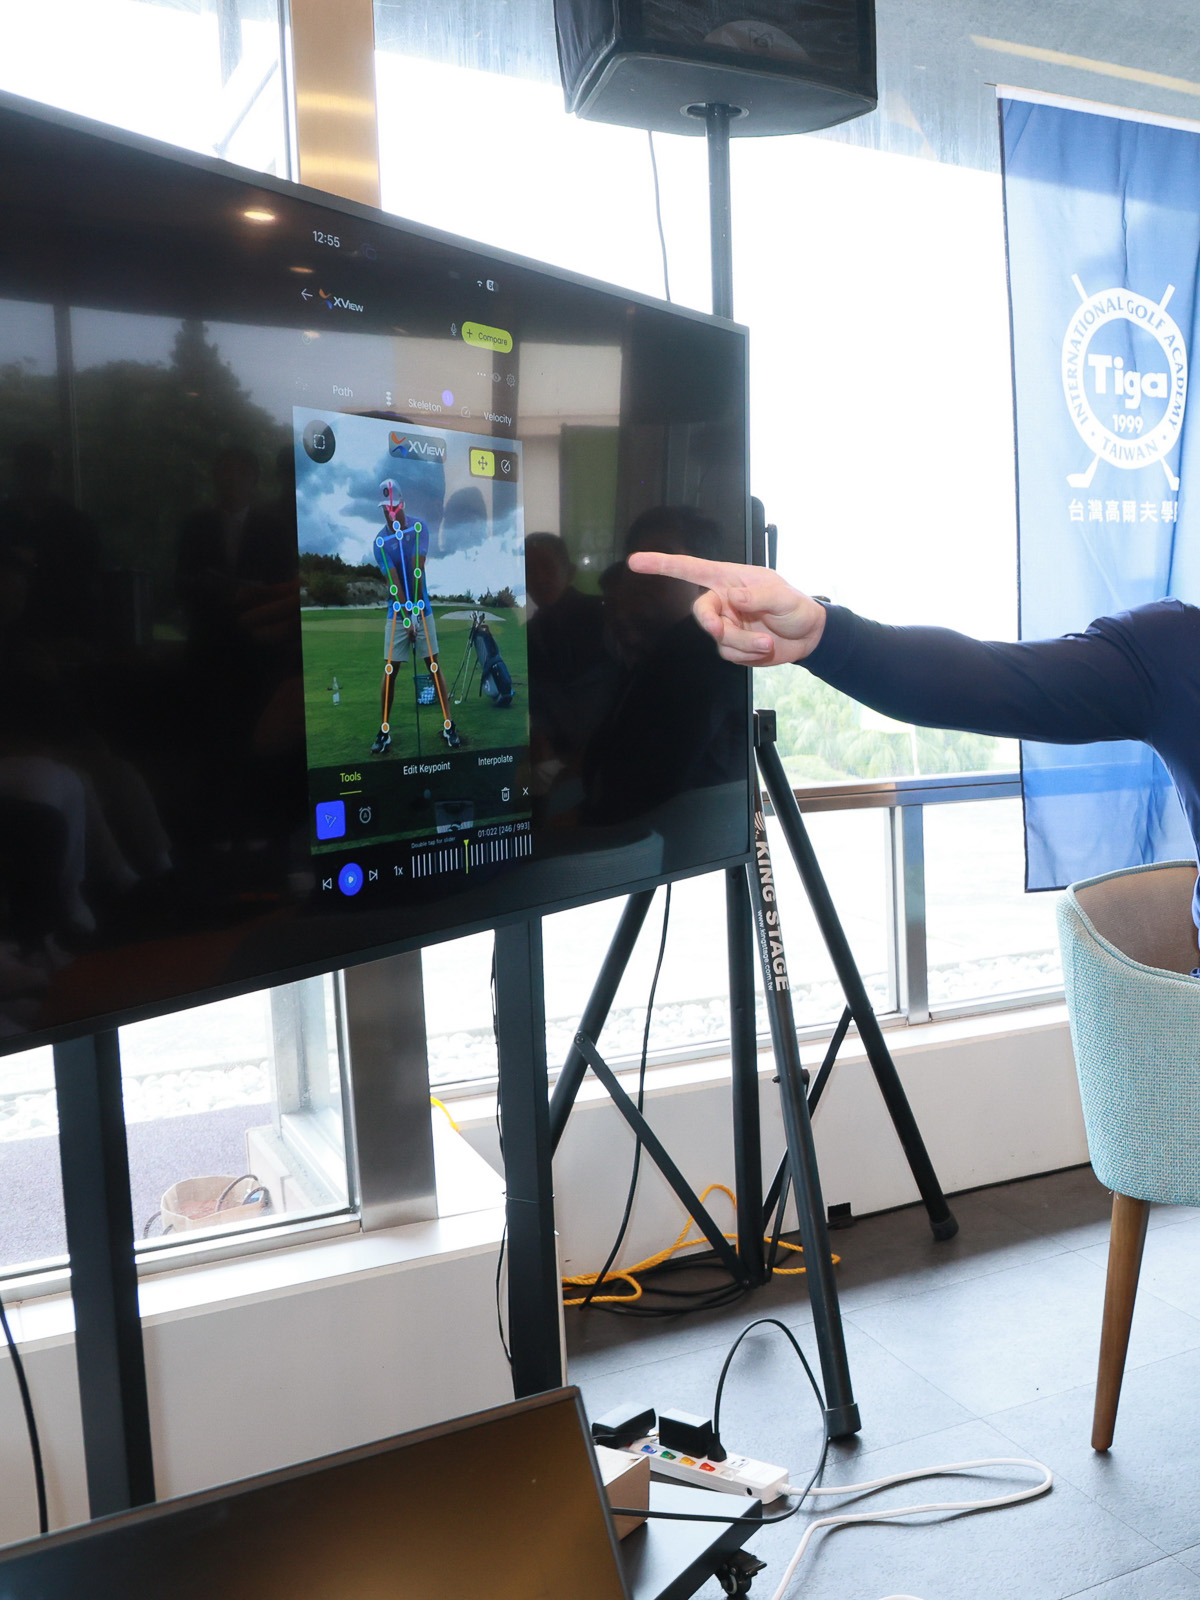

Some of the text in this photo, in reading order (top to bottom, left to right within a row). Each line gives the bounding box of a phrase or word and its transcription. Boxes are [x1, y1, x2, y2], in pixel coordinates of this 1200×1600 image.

[312, 230, 340, 248] 12:55
[478, 331, 508, 346] Compare
[1066, 296, 1185, 431] INTERNATIONAL GOLF ACADEMY
[1087, 353, 1168, 409] Tiga
[332, 385, 354, 397] Path
[408, 398, 442, 413] Skeleton
[483, 411, 512, 426] Velocity
[1112, 413, 1144, 435] 1999
[1101, 436, 1159, 461] TAIWAN
[1068, 498, 1178, 523] 台灣高爾夫學
[403, 761, 451, 775] Edit Keypoint
[478, 754, 513, 767] Interpolate
[340, 771, 362, 783] Tools
[478, 827, 498, 838] 01:022
[393, 866, 404, 876] 1x
[755, 841, 790, 992] KING STAGE
